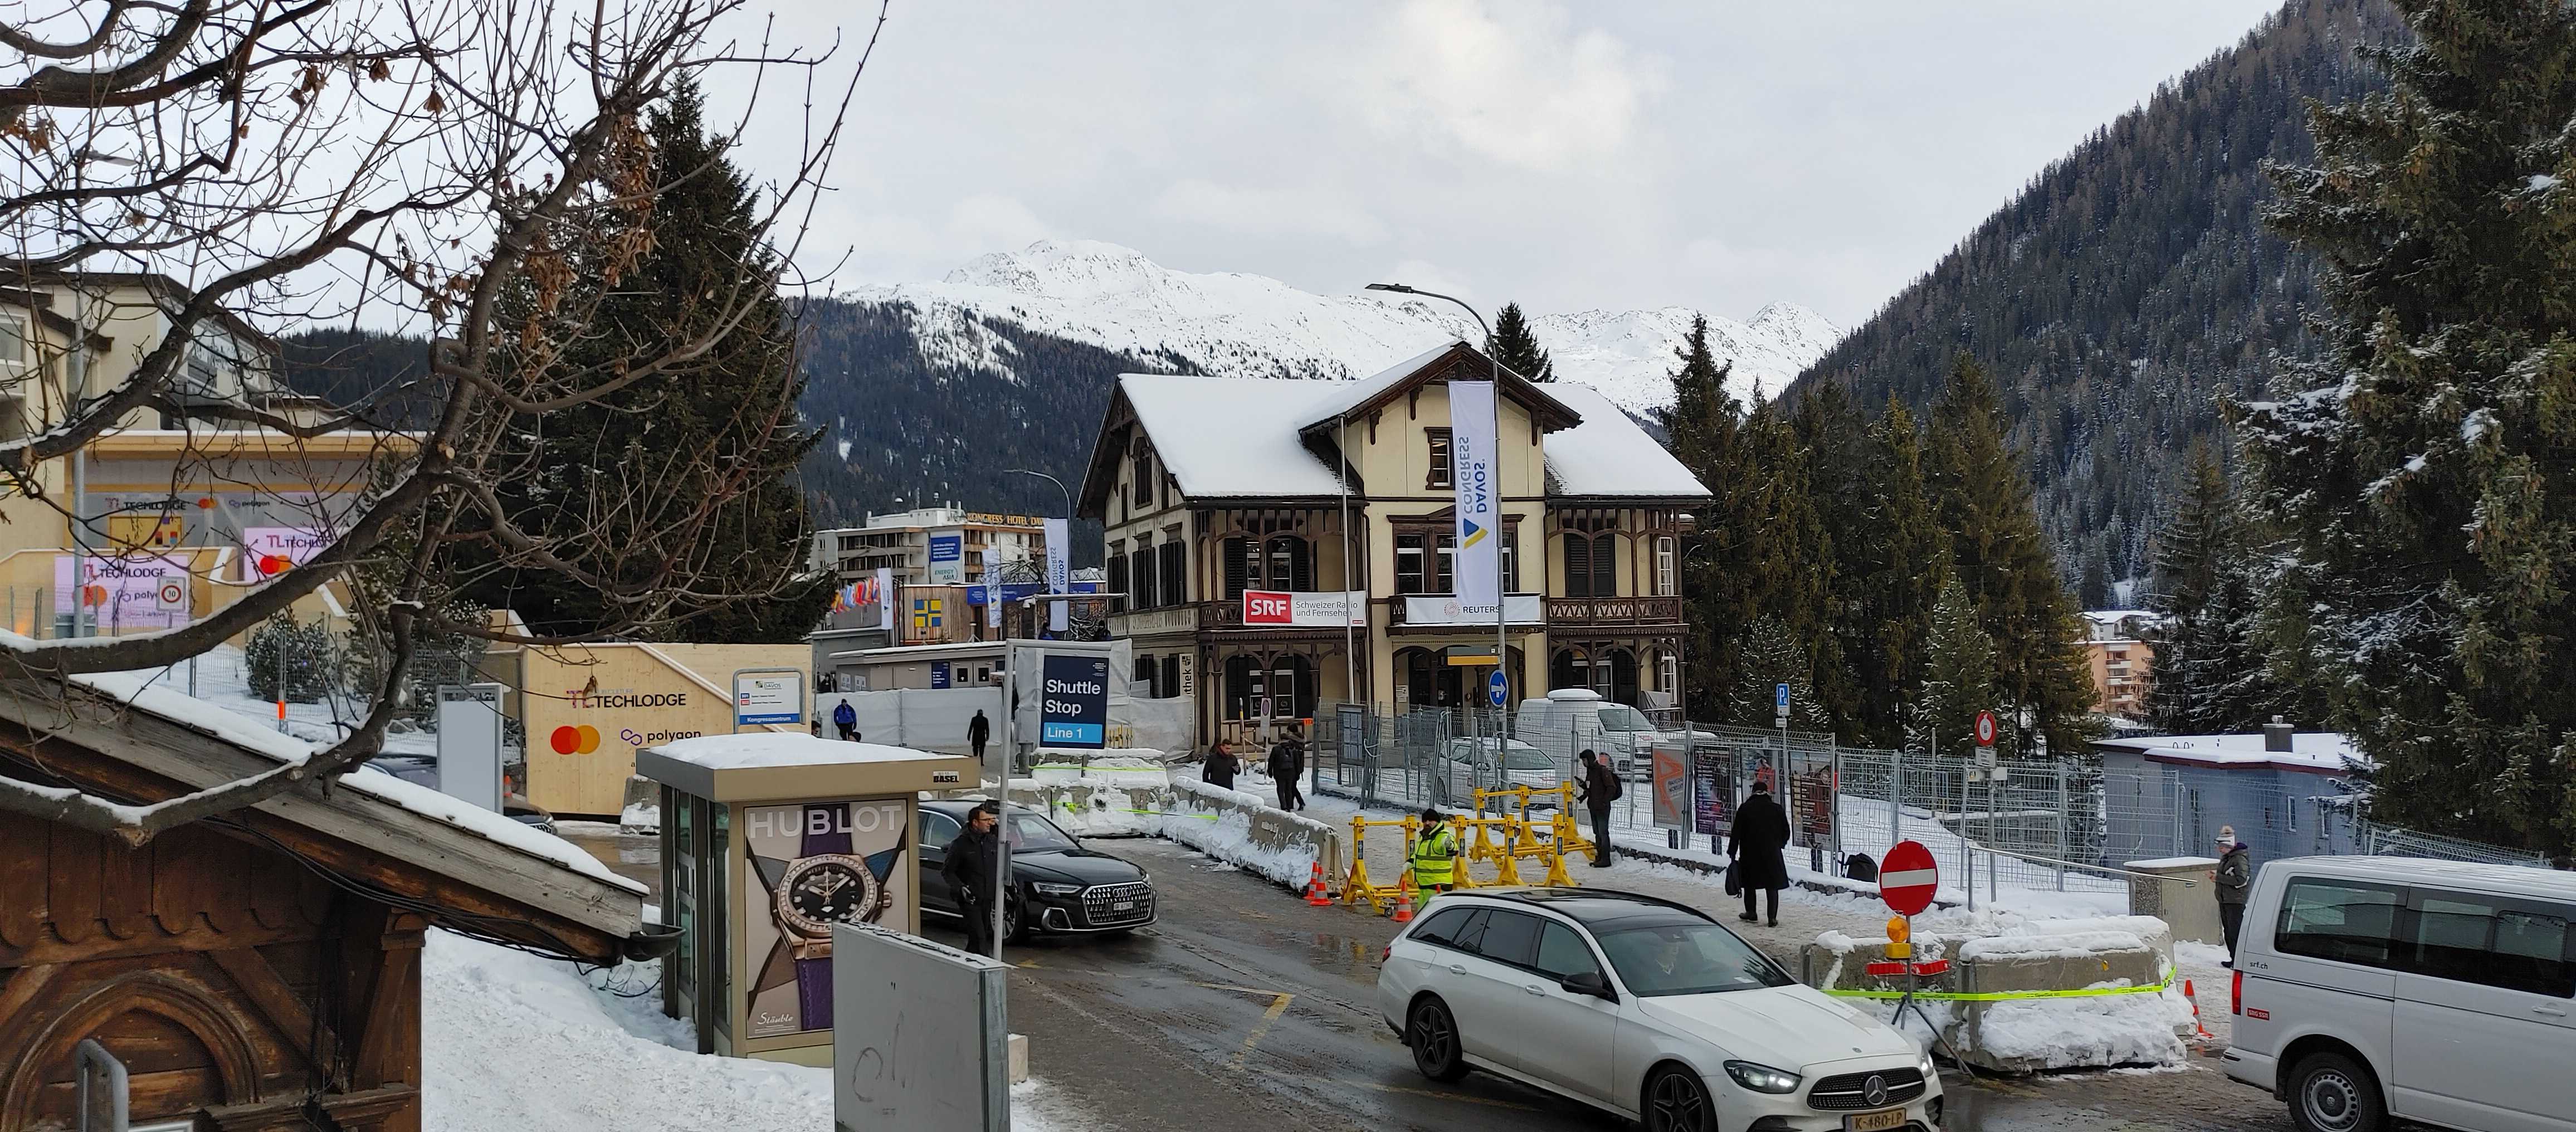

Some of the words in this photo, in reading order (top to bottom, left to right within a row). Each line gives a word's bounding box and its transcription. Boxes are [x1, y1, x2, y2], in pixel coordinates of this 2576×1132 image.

[124, 501, 186, 510] TECHLOGE
[967, 513, 1003, 524] KONGRESS
[1007, 515, 1028, 525] HOTEL
[1031, 517, 1044, 526] DAV
[1251, 599, 1286, 616] SRF
[1463, 606, 1500, 614] REUTERS
[1046, 679, 1101, 695] Shuttle
[1182, 668, 1192, 695] thek
[596, 694, 686, 708] TECHLODGE
[1045, 699, 1082, 717] Stop
[1047, 727, 1074, 738] Line
[1077, 728, 1082, 739] 1
[749, 805, 902, 838] HUBLOT
[2250, 962, 2268, 970] srf.ch
